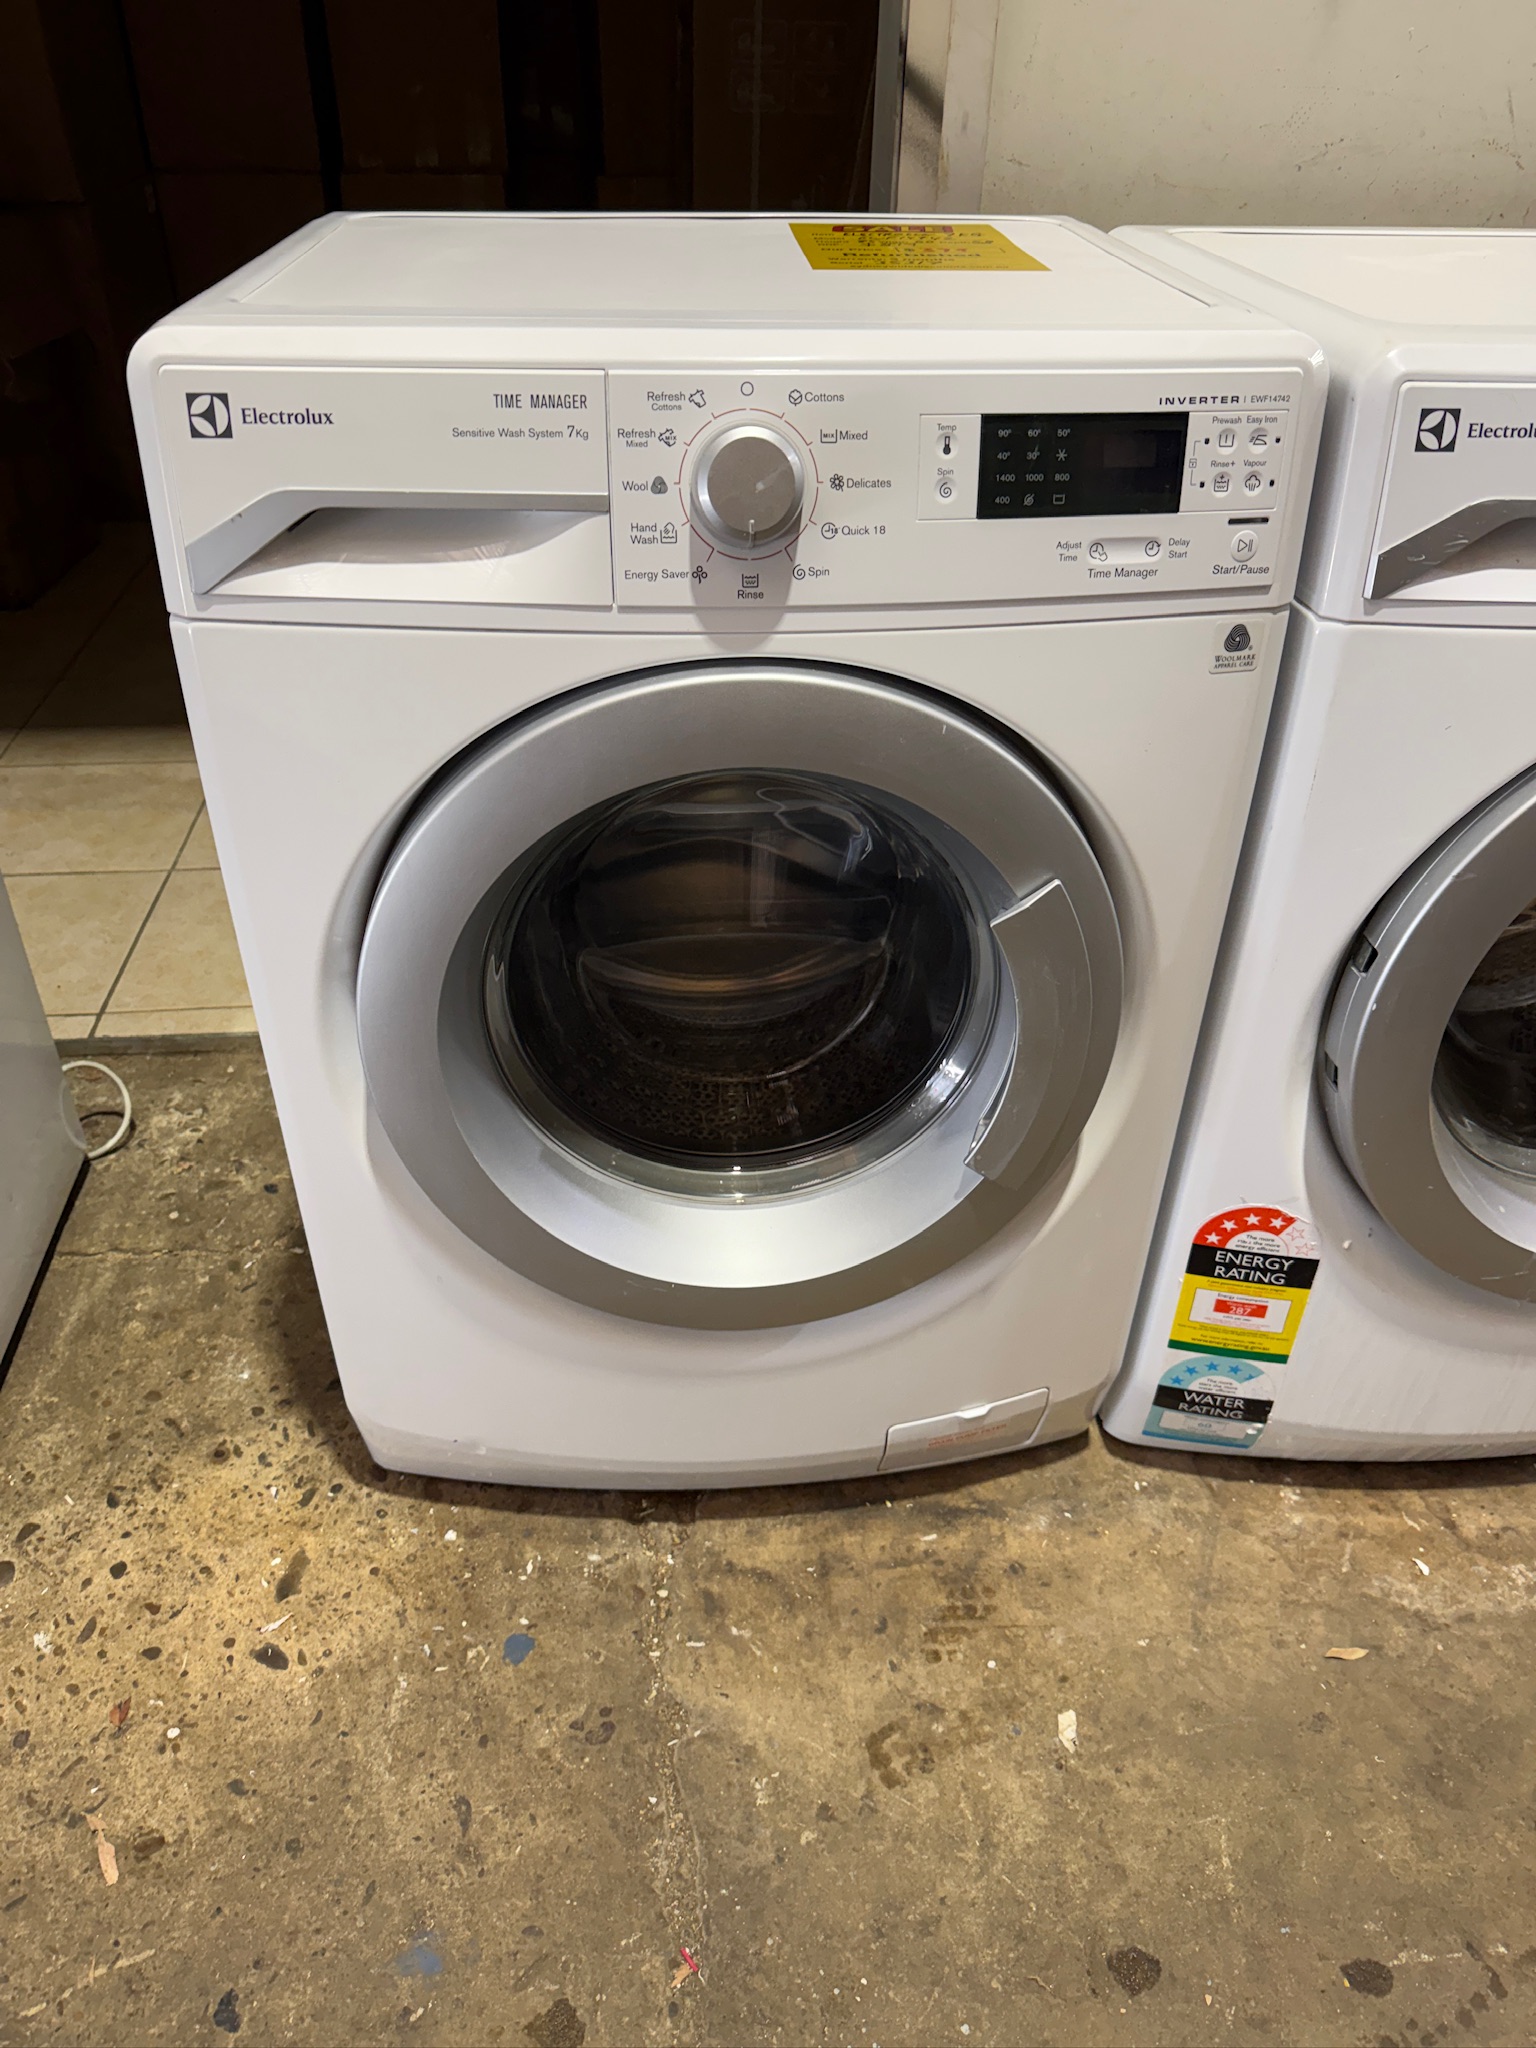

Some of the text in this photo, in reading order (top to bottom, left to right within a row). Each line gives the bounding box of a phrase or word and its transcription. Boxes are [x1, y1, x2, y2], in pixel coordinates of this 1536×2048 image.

[493, 394, 588, 409] TIME MANAGER
[647, 391, 686, 402] Refresh
[804, 392, 845, 402] Cottons
[1159, 395, 1291, 406] INVERTER EWF14742
[651, 403, 682, 411] Cottons
[241, 407, 335, 425] Electrolux
[1212, 416, 1242, 424] Prewash
[1246, 415, 1278, 425] Easy Iron
[937, 423, 957, 432] Temp
[1467, 422, 1536, 439] Electrol
[452, 427, 495, 438] Sensitive
[497, 427, 526, 438] Wash
[528, 427, 564, 440] System
[617, 429, 656, 439] Refresh
[839, 430, 868, 440] Mixed
[626, 439, 648, 448] Mixed
[1243, 459, 1267, 468] Vapour
[937, 467, 954, 477] Spin
[995, 473, 1070, 482] 1400 1000 800
[622, 480, 648, 491] Wool
[846, 478, 892, 489] Delicates
[995, 496, 1010, 504] 400
[631, 522, 657, 533] Hand
[841, 525, 886, 536] Quick 18
[630, 535, 658, 545] Wash
[1168, 538, 1191, 548] Delay
[1056, 541, 1082, 551] Adjust
[1059, 553, 1078, 562] Time
[1168, 550, 1188, 559] Start
[624, 569, 689, 581] Energy Saver
[808, 567, 830, 577] Spin
[1088, 567, 1159, 579] Time Manager
[1212, 564, 1269, 576] Start/Pause
[737, 589, 764, 600] Rinse
[1214, 653, 1256, 663] WOOLMARK
[1214, 1250, 1295, 1272] ENERGY
[1214, 1265, 1287, 1285] RATING
[1229, 1306, 1252, 1316] 287
[1184, 1391, 1245, 1409] WATER
[1178, 1402, 1244, 1419] RATING
